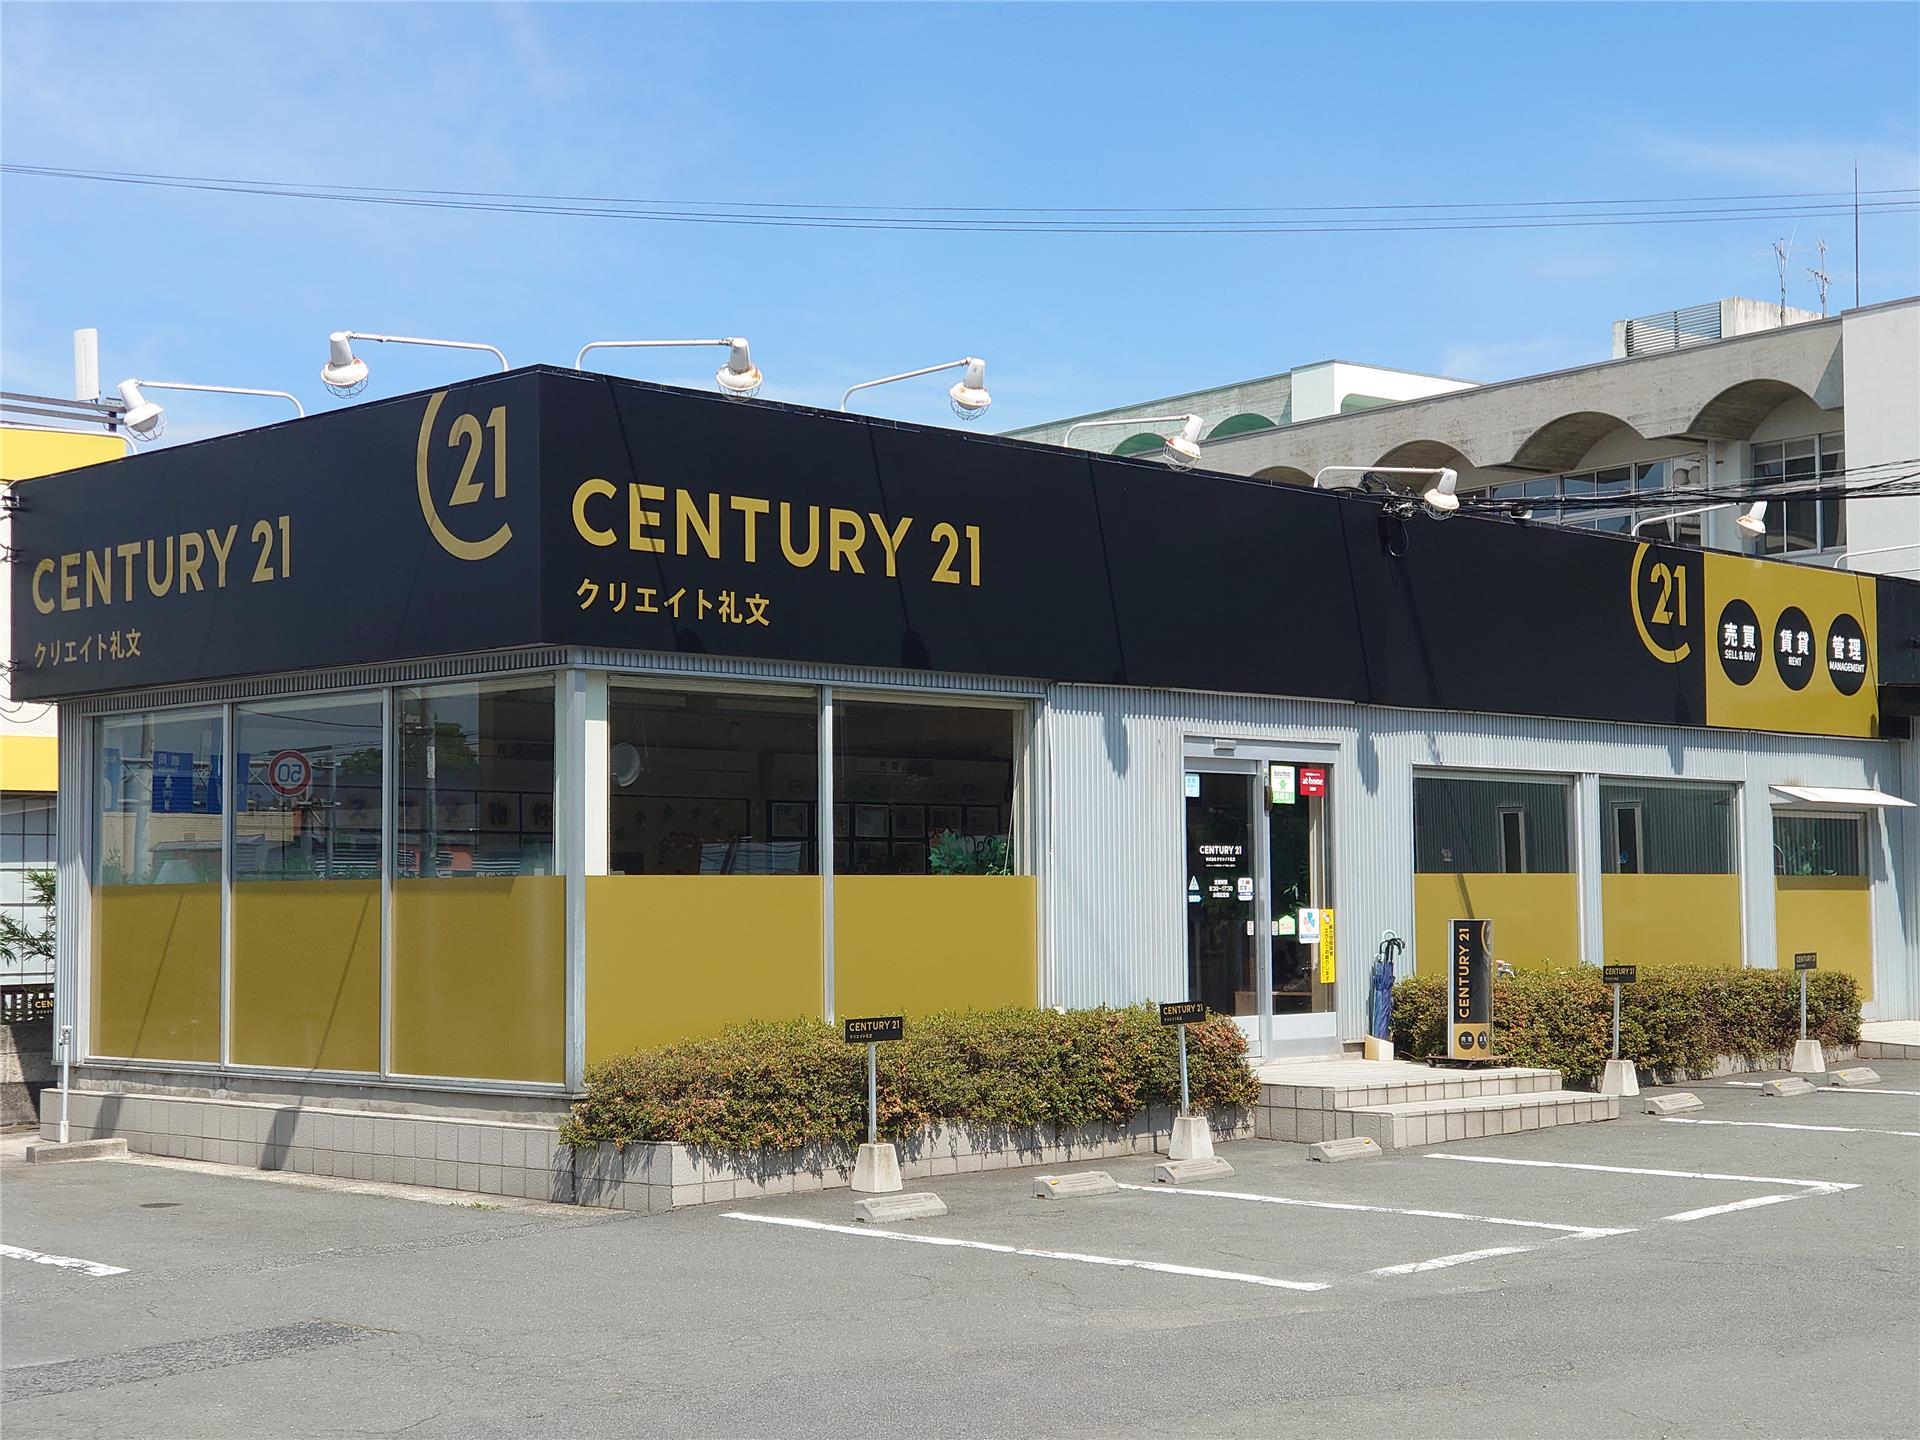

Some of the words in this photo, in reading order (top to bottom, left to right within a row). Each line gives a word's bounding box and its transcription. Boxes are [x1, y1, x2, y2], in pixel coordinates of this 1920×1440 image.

[571, 478, 913, 578] CENTURY
[930, 521, 981, 587] 21
[32, 524, 238, 615] CENTURY
[251, 515, 291, 582] 21
[576, 577, 770, 627] クリエイト礼文
[34, 628, 142, 668] クリエイト礼文
[1724, 622, 1756, 650] 売買
[1780, 628, 1809, 656] 賃貸
[1832, 634, 1862, 661] 管理
[1724, 649, 1738, 660] SELL
[1739, 650, 1744, 660] &
[1744, 651, 1756, 662] BUY
[1788, 656, 1802, 667] RENT
[1829, 661, 1864, 674] MANAGEMENT
[1199, 845, 1234, 854] CENTURY
[1235, 846, 1242, 854] 21
[1459, 928, 1470, 942] 21
[1458, 947, 1470, 1018] CENTURY
[1163, 1004, 1195, 1015] CENTURY
[1197, 1003, 1203, 1012] 21
[849, 1021, 890, 1031] CENTURY
[892, 1020, 899, 1029] 21
